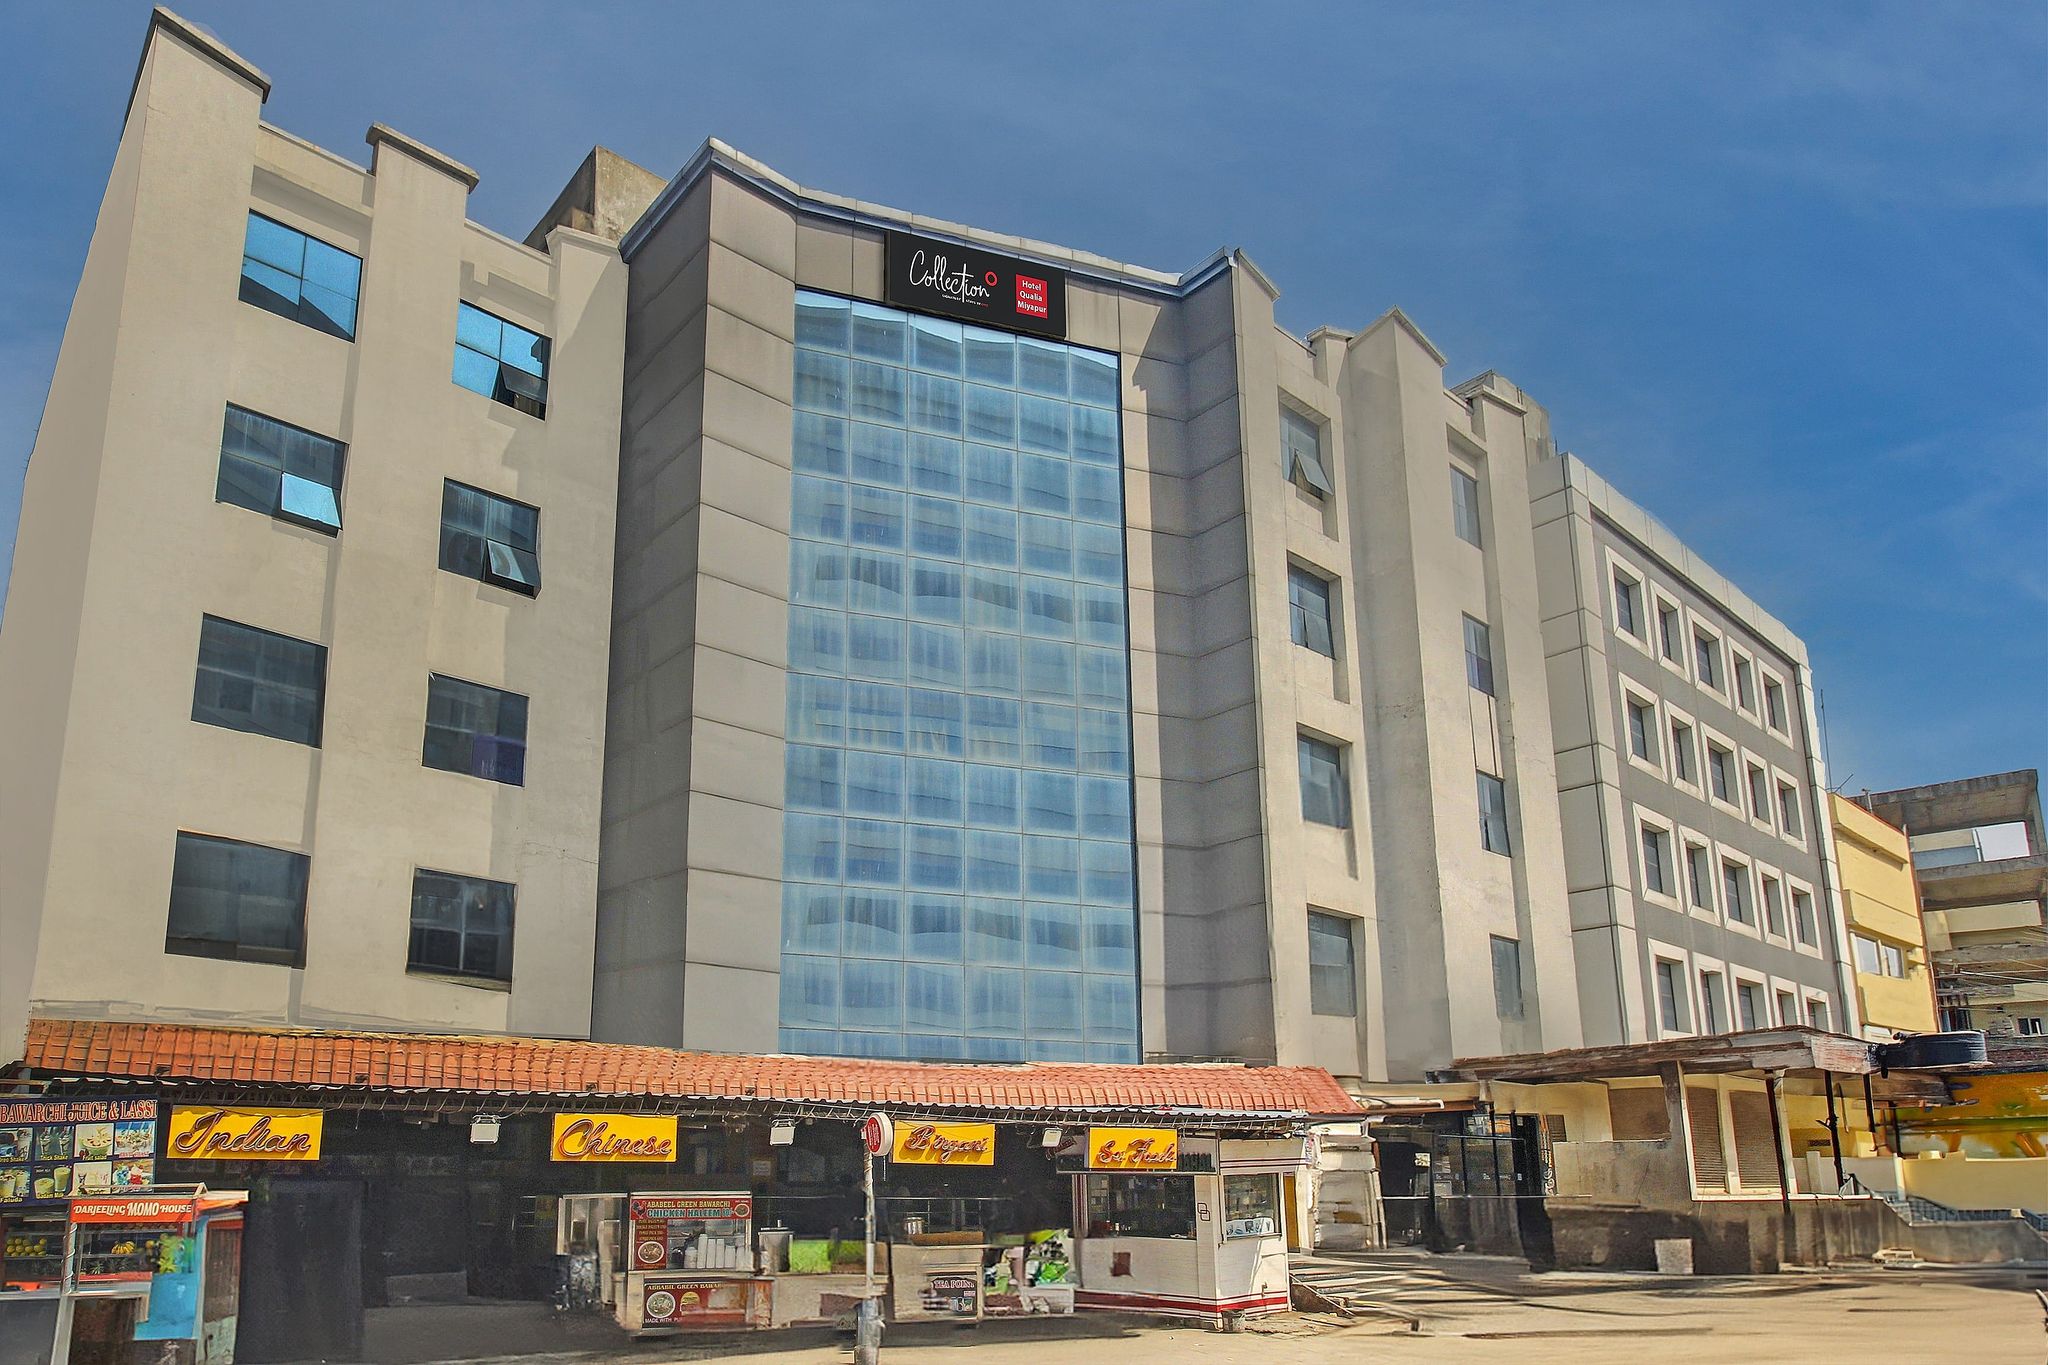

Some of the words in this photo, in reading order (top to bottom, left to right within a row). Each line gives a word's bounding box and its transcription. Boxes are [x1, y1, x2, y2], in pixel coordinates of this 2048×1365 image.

[909, 250, 990, 303] Collection
[1022, 280, 1042, 291] Hotel
[1019, 290, 1042, 302] Qualia
[1017, 300, 1047, 313] Miyapur
[0, 1103, 67, 1124] BAWARCHI
[67, 1101, 108, 1121] JUICE
[108, 1101, 119, 1120] &
[120, 1100, 157, 1120] LASSI
[175, 1110, 312, 1153] Indian
[558, 1118, 673, 1158] Chinese
[73, 1204, 126, 1216] DARJEELING
[126, 1202, 160, 1216] MOMO
[160, 1204, 192, 1213] HOUSE
[699, 1200, 731, 1208] BAWARCHI
[647, 1209, 686, 1218] CHICKEN
[687, 1208, 721, 1218] HALEEM
